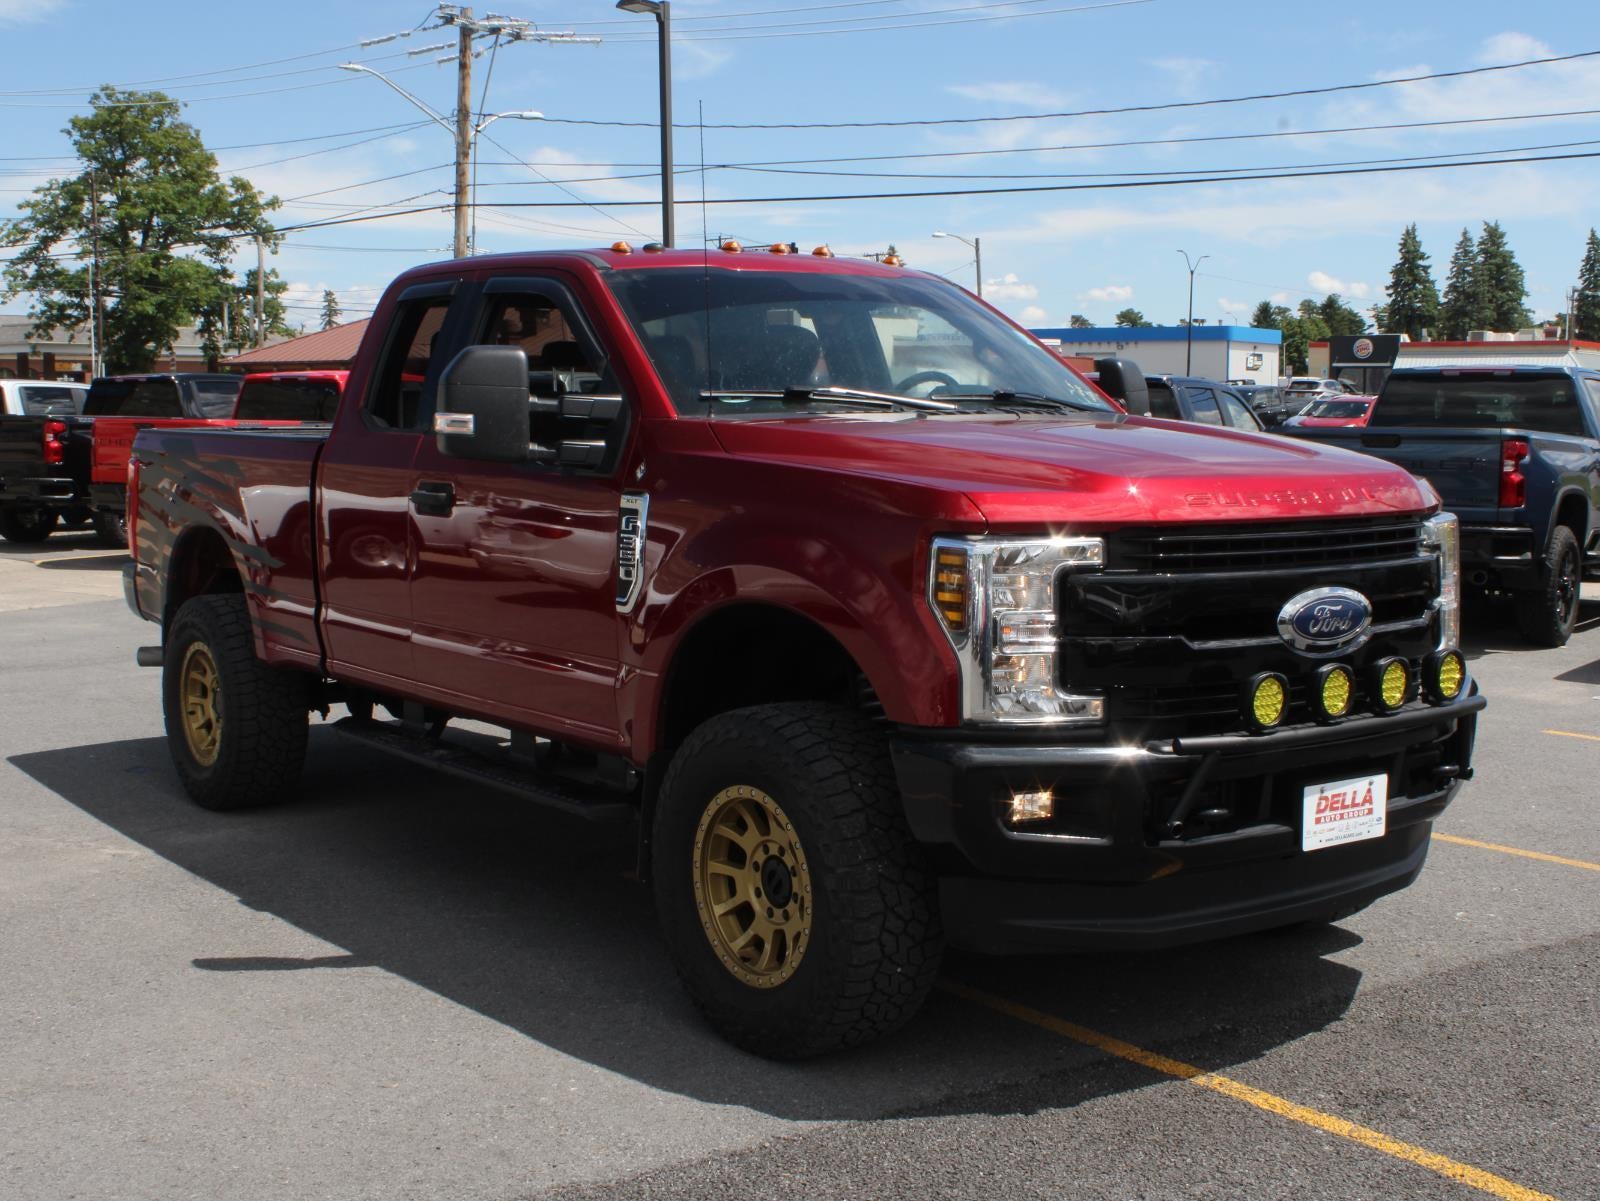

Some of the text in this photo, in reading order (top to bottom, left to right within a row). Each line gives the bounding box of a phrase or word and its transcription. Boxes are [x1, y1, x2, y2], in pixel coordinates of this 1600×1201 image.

[1308, 604, 1353, 634] Ford
[1315, 787, 1373, 815] DELLA
[1320, 809, 1369, 824] AUTO GROUP
